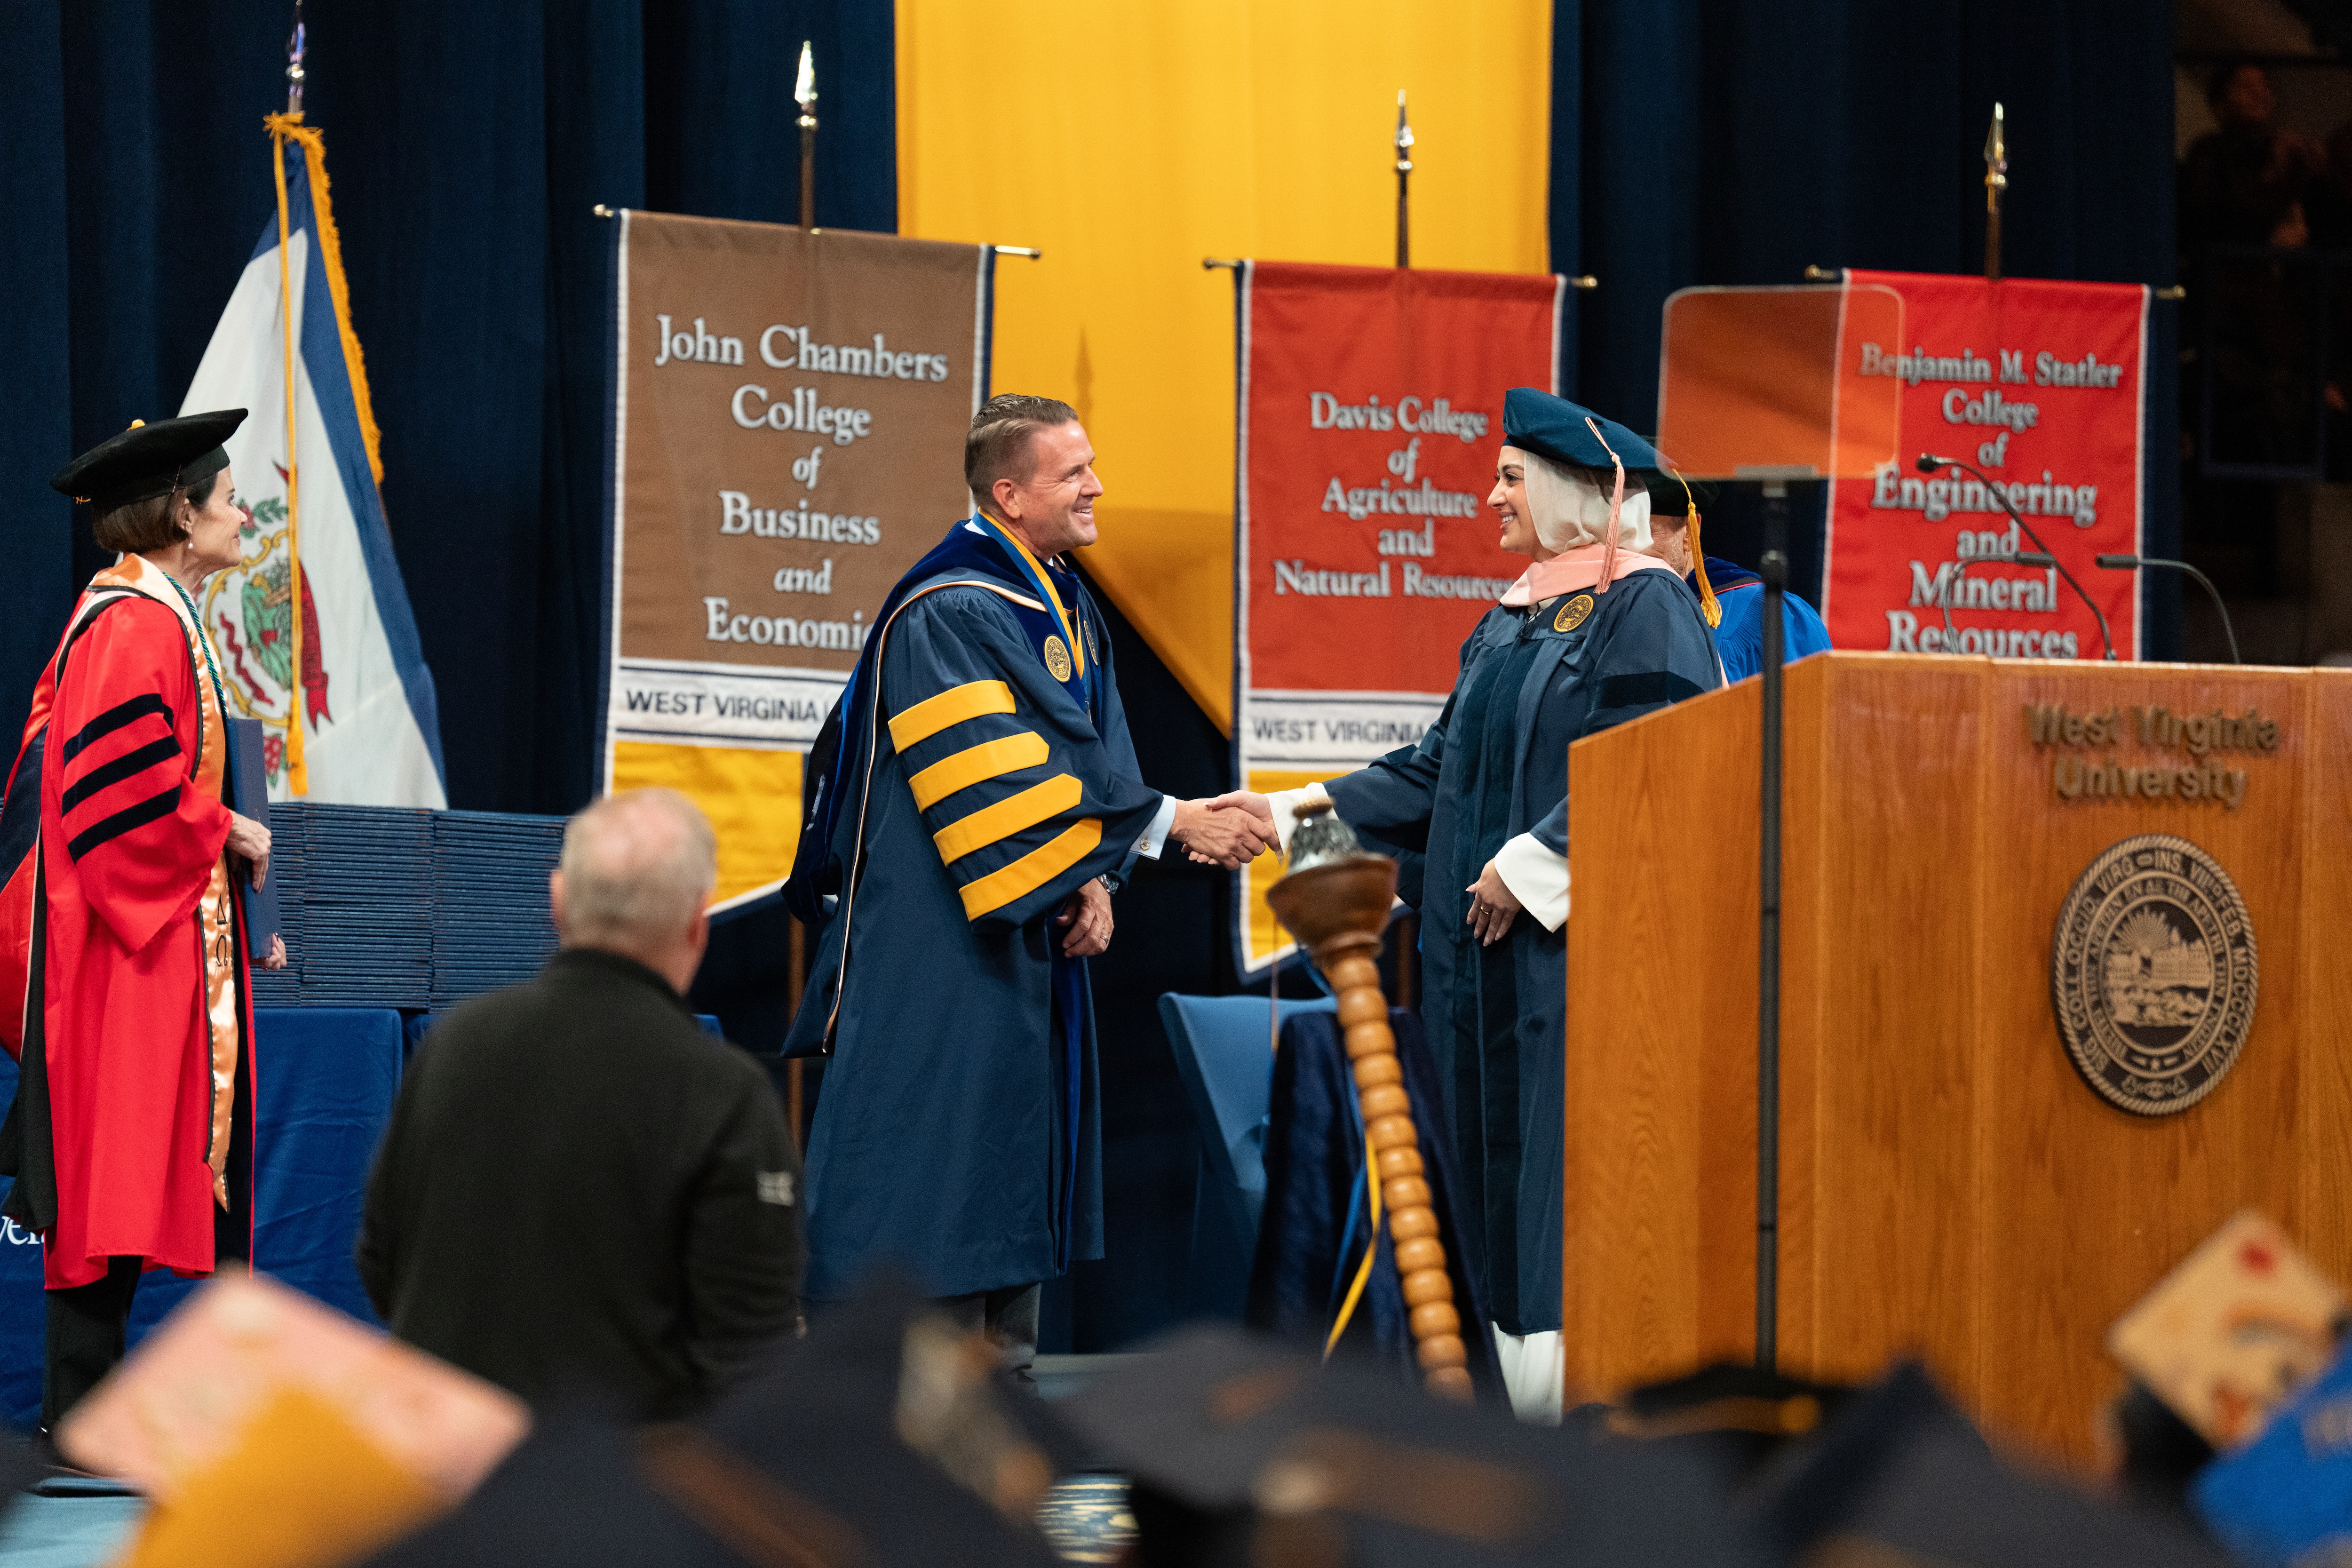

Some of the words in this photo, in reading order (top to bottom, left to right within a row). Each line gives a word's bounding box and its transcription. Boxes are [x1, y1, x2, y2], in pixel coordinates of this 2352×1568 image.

[656, 315, 743, 365] John
[760, 325, 947, 381] Chambers
[1859, 342, 1992, 385] Benjamin
[2000, 350, 2026, 382] M.
[2035, 352, 2122, 386] Statler
[732, 385, 871, 444] College
[1311, 392, 1394, 430] Davis
[1397, 397, 1487, 443] College
[1943, 389, 2038, 433] College
[793, 447, 822, 488] of
[1387, 438, 1420, 484] of
[1979, 432, 2009, 466] of
[719, 491, 880, 544] Business
[1322, 477, 1477, 519] Agriculture
[1871, 463, 2097, 527] Engineering
[1378, 519, 1434, 556] and
[1957, 520, 2019, 558] and
[774, 559, 832, 593] and
[1276, 561, 1391, 596] Natural
[1908, 561, 2057, 611] Mineral
[1885, 611, 2079, 659] Resources
[627, 691, 706, 714] WEST
[714, 695, 818, 722] VIRGINIA
[1253, 718, 1316, 741] WEST
[2024, 705, 2119, 745] West
[2131, 706, 2280, 754] Virginia
[2054, 756, 2246, 808] University
[2201, 945, 2248, 1075] MDCCCLXVII
